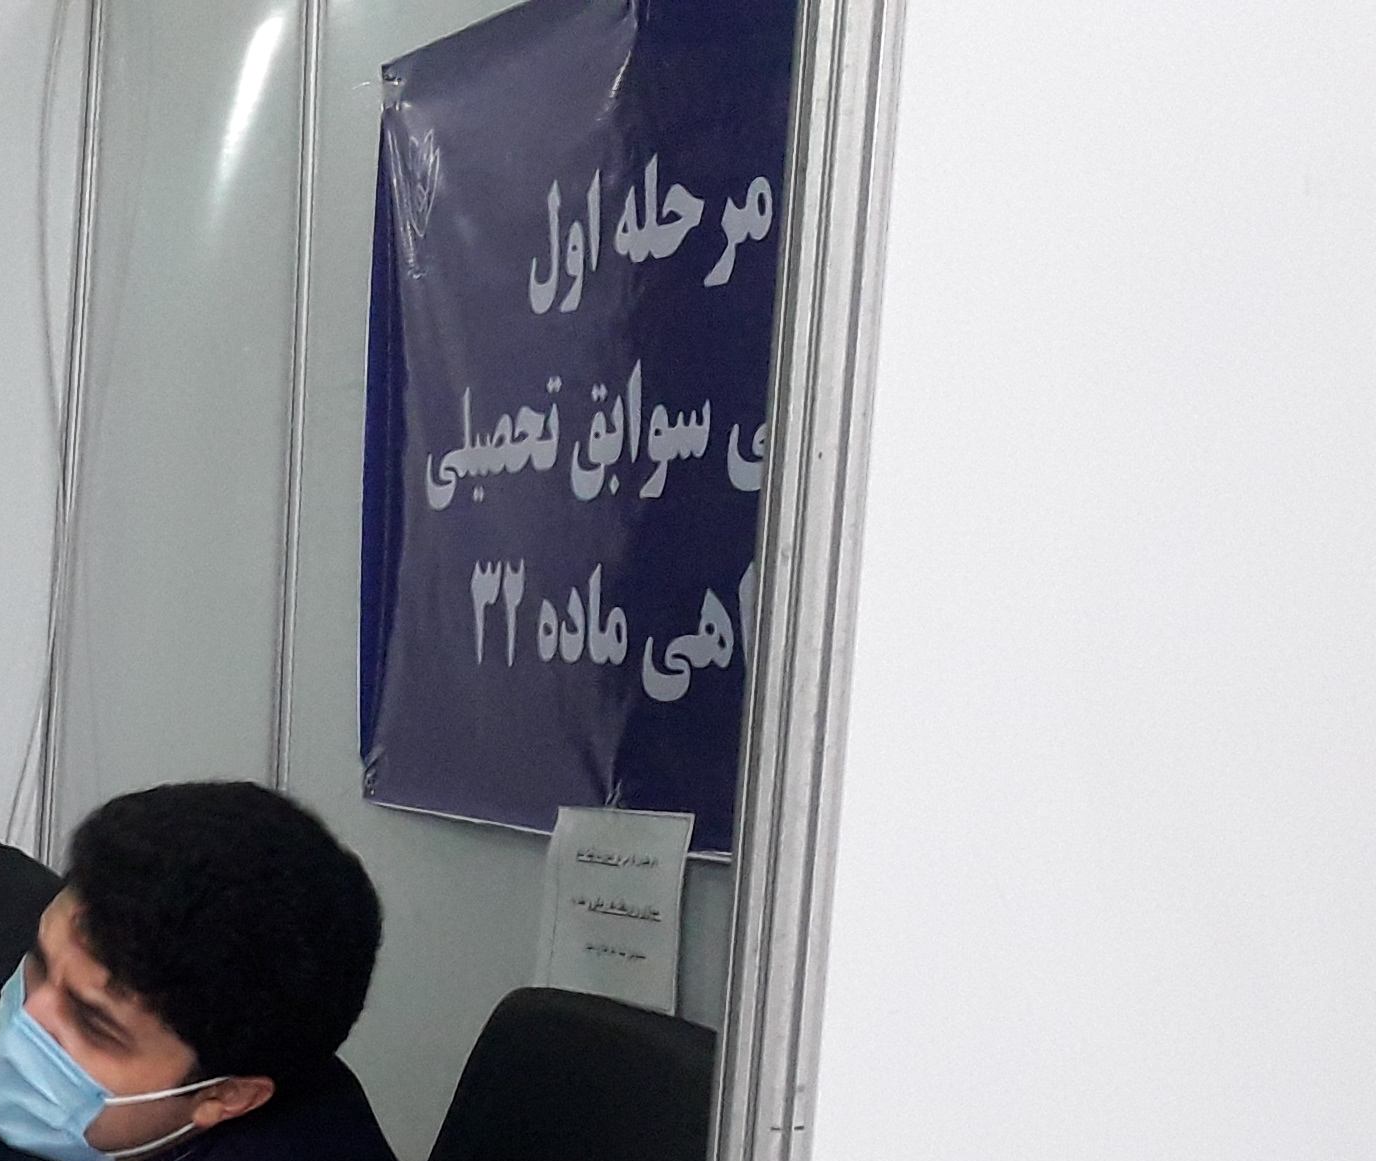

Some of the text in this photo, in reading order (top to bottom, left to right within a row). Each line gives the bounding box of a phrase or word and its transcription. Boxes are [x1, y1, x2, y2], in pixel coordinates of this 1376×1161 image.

[528, 152, 773, 315] مرحله اول
[426, 374, 562, 512] تحصیلی
[571, 358, 711, 502] سوابق
[470, 557, 756, 702] اهی ماده ۳۲
